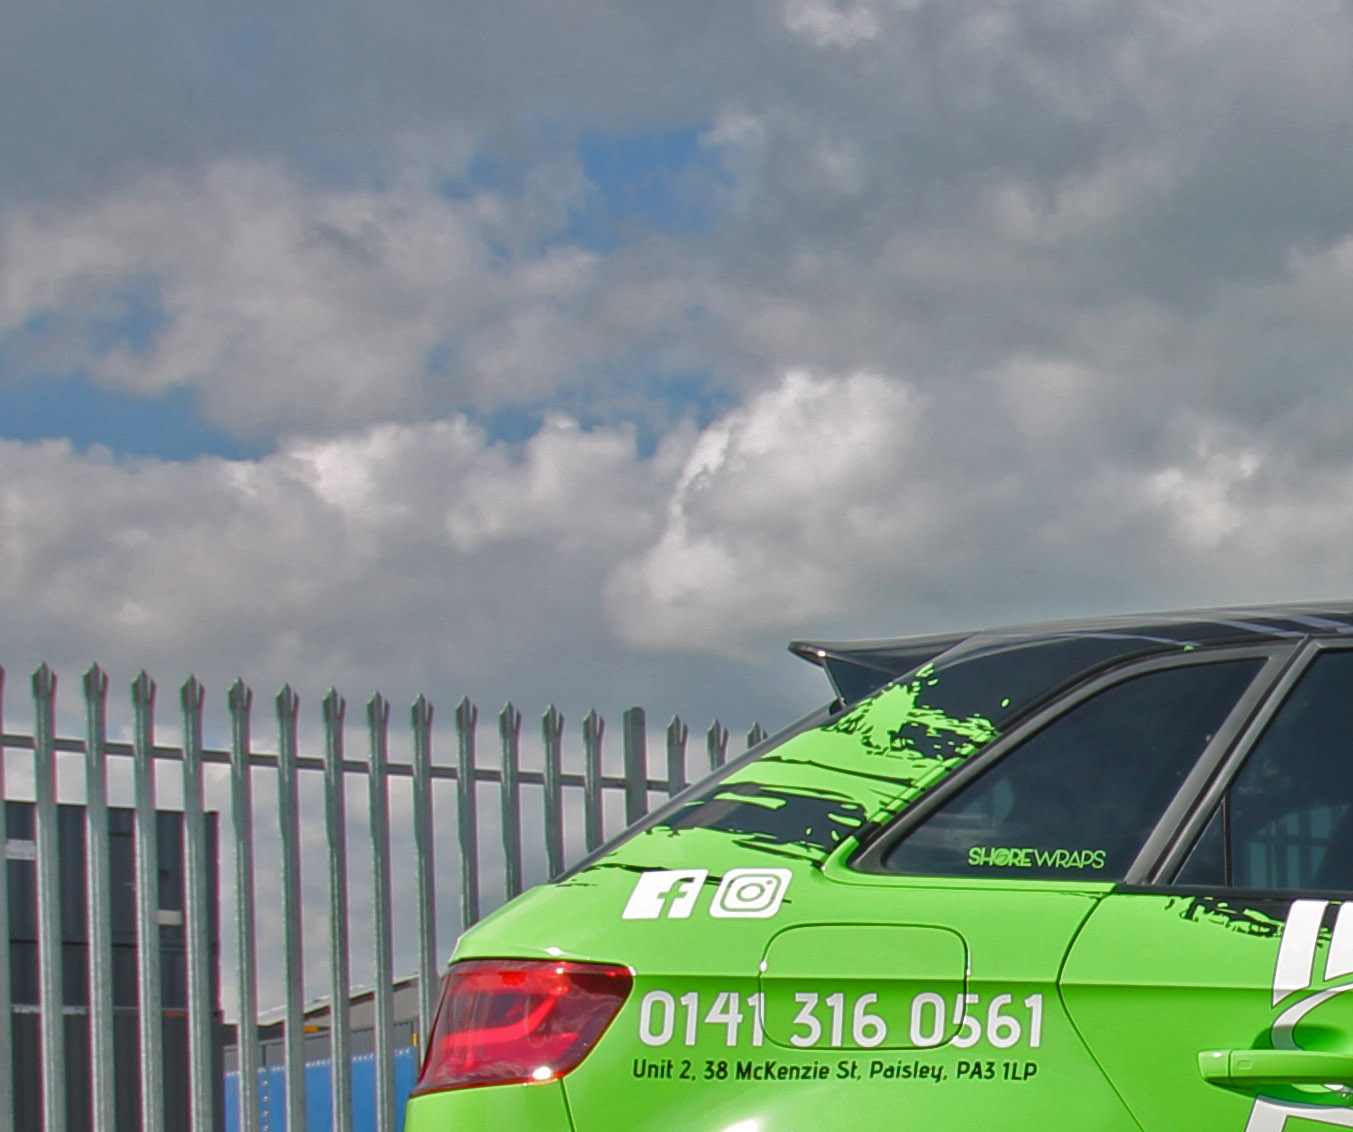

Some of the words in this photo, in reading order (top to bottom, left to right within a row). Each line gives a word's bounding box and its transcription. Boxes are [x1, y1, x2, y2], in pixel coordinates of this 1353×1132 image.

[638, 990, 764, 1048] 0141
[790, 992, 887, 1048] 316
[909, 992, 1044, 1049] 0561
[633, 1058, 674, 1080] Unit
[678, 1060, 696, 1082] 2,
[703, 1060, 728, 1080] 38
[735, 1060, 830, 1081] McKenzie
[869, 1060, 948, 1084] Paisley,
[957, 1061, 996, 1080] PA3
[1002, 1062, 1038, 1082] 1LP
